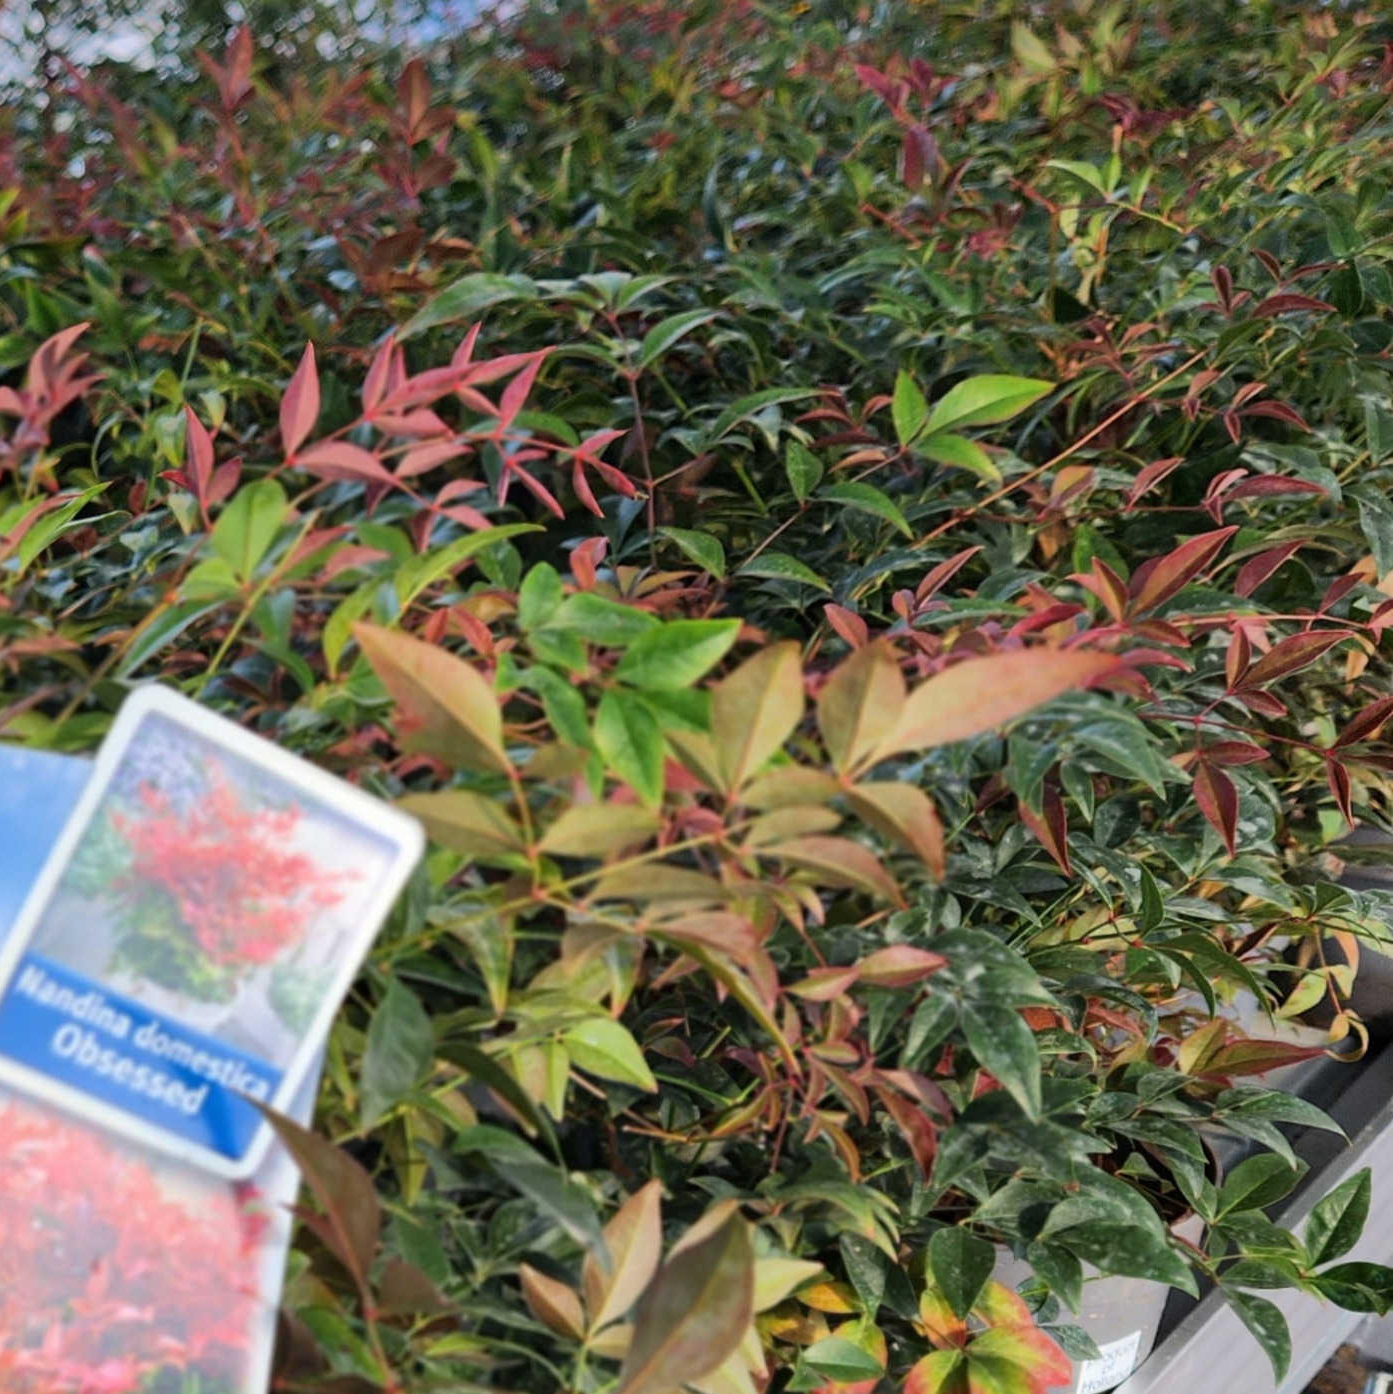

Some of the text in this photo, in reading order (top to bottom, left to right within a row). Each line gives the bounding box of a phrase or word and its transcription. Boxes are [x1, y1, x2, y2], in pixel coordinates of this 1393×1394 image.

[13, 965, 270, 1099] Nandina domestica
[52, 1023, 208, 1114] Obsessed
